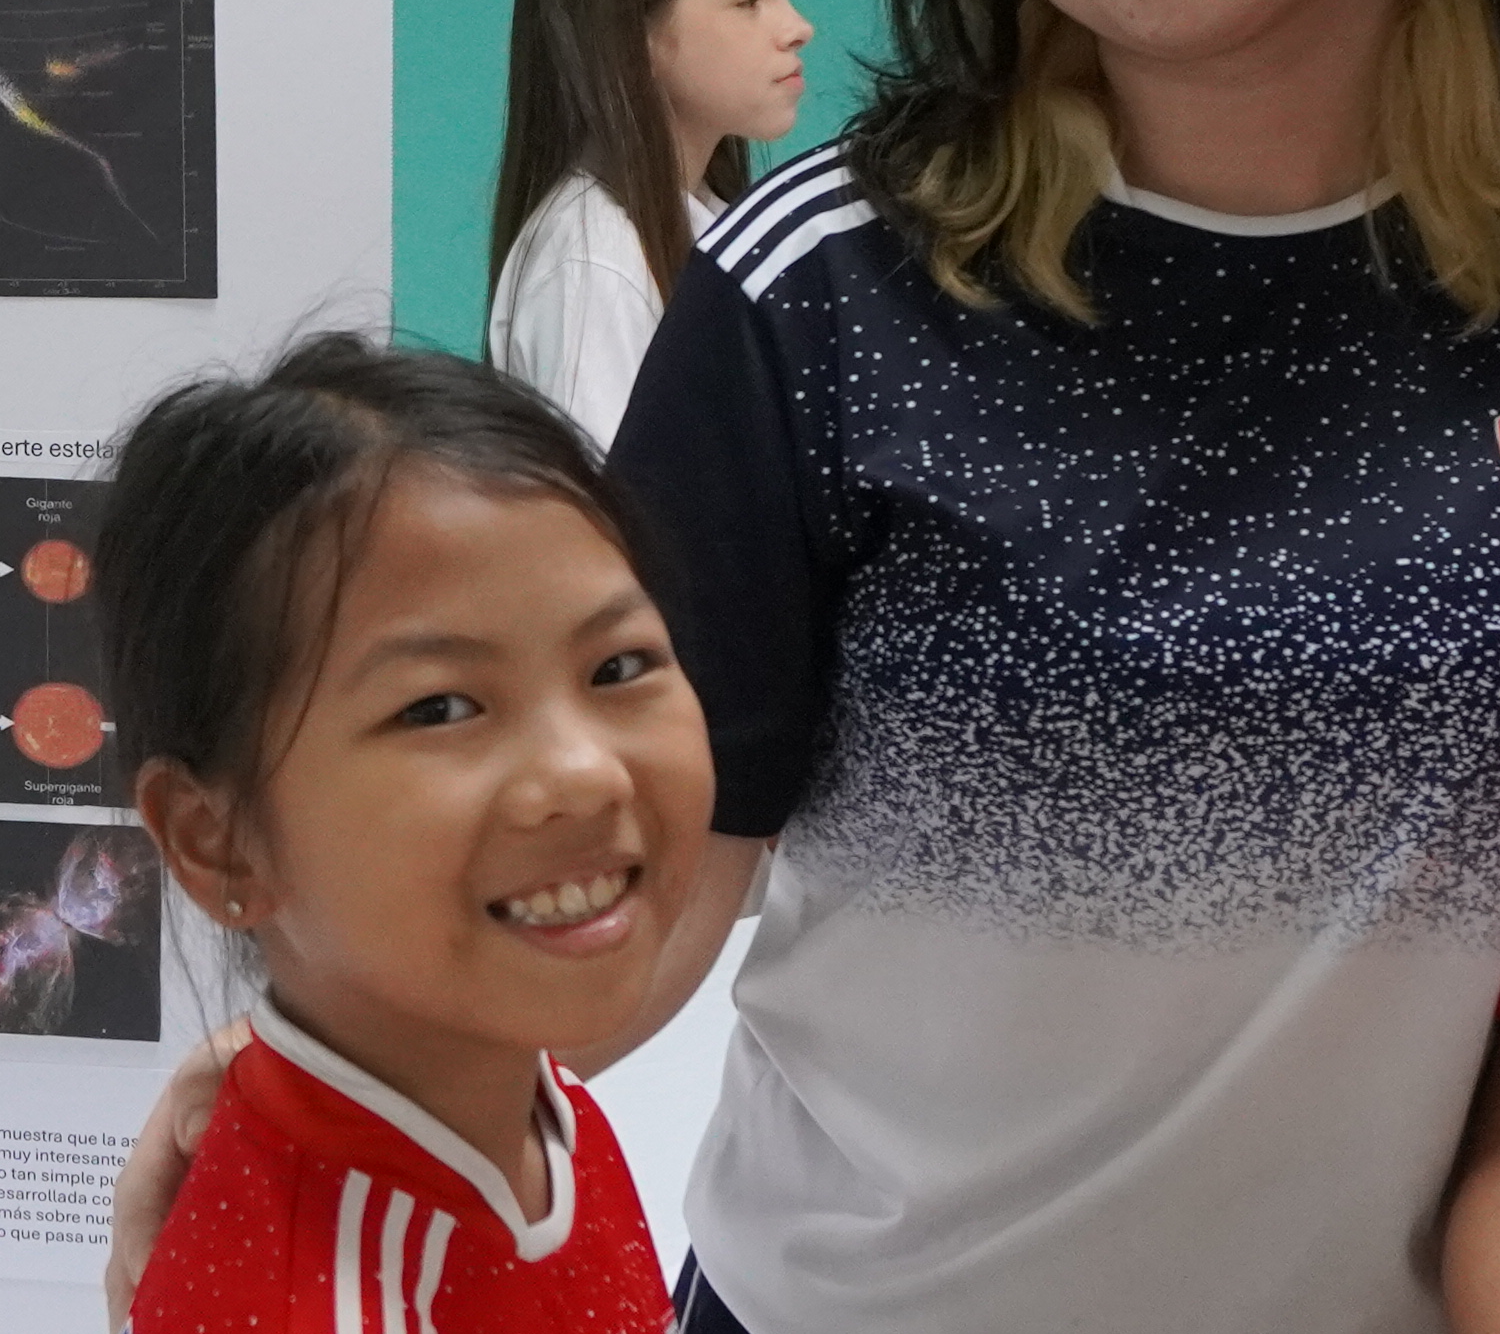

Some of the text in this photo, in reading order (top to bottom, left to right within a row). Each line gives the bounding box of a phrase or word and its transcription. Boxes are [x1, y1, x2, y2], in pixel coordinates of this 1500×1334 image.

[26, 497, 73, 511] Gigante
[38, 511, 61, 523] roja
[24, 780, 101, 795] Supergigante
[52, 795, 74, 806] roja
[68, 1133, 97, 1146] que
[102, 1133, 116, 1146] la
[36, 1148, 126, 1167] interesante
[12, 1168, 36, 1181] tan
[41, 1169, 95, 1187] simple
[36, 1210, 80, 1224] sobre
[11, 1229, 40, 1241] que
[45, 1232, 84, 1244] pasa
